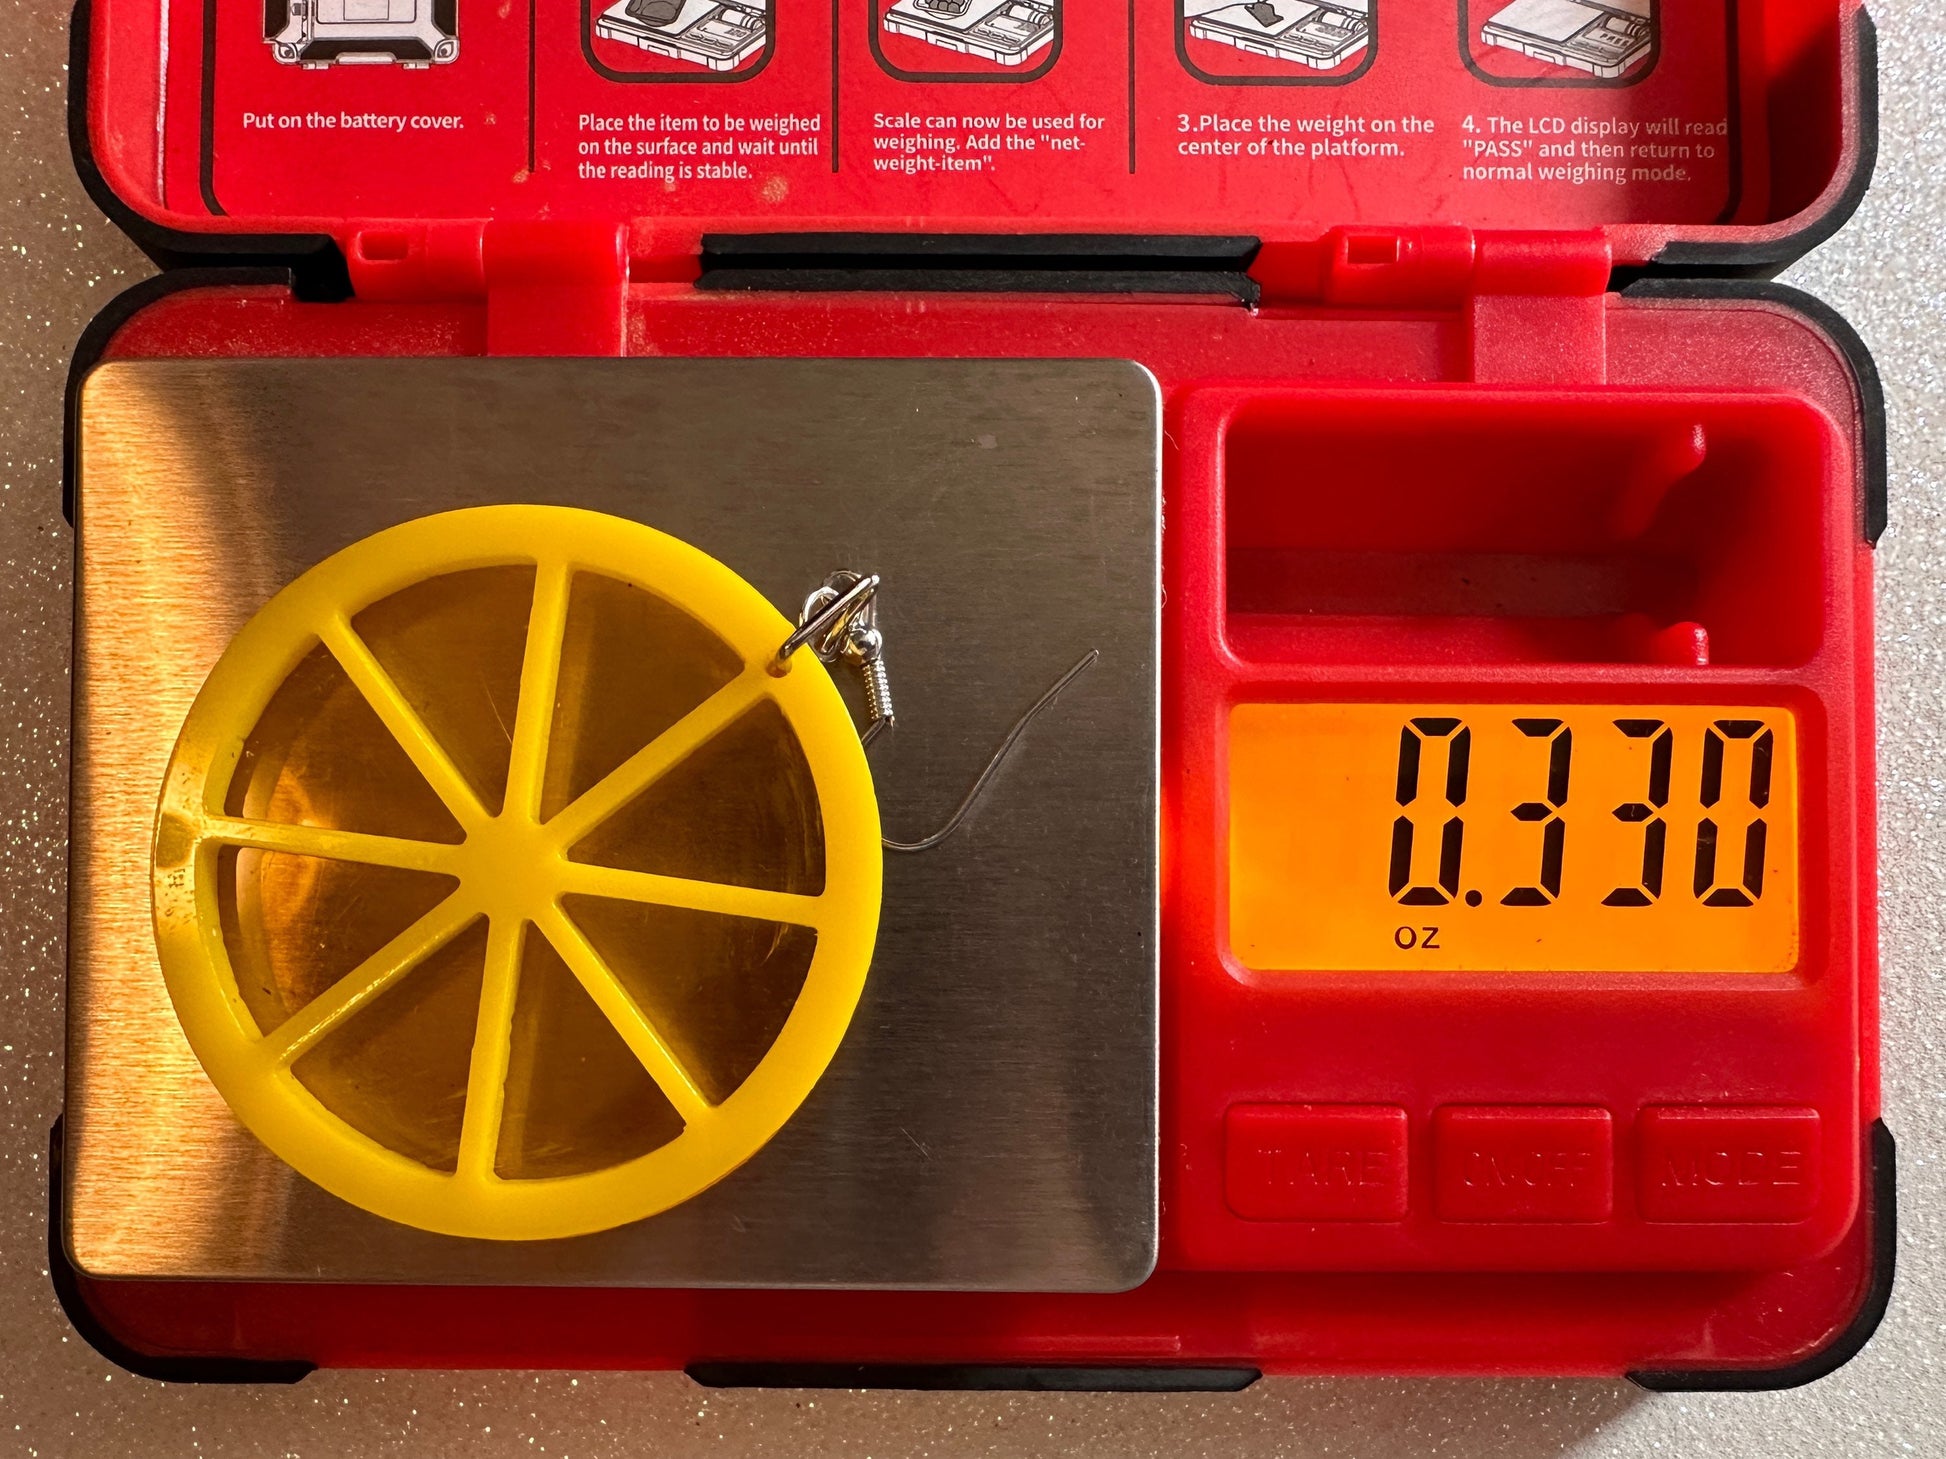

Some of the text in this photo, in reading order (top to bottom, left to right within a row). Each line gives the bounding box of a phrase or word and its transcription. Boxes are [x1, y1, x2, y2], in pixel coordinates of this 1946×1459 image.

[243, 111, 464, 133] Put on the battery cover.
[578, 113, 821, 136] Place the item to be weighed
[873, 112, 1105, 129] Scale can now be used for
[1257, 115, 1291, 133] the
[1296, 115, 1365, 137] weight
[1370, 118, 1396, 133] on
[1401, 115, 1435, 133] the
[1462, 115, 1728, 139] 4. The LCD display will read
[578, 137, 818, 155] on the surface and wait until
[873, 134, 1086, 153] weighing. Add the "net-
[1178, 137, 1405, 160] center of the platform.
[1463, 140, 1715, 158] "PASS" and then return to
[578, 161, 753, 183] the reading is stable.
[1463, 162, 1691, 185] normal weighing mode.
[1389, 718, 1773, 907] 0.330
[1258, 1149, 1392, 1187] TARE
[1661, 1151, 1801, 1187] MODE
